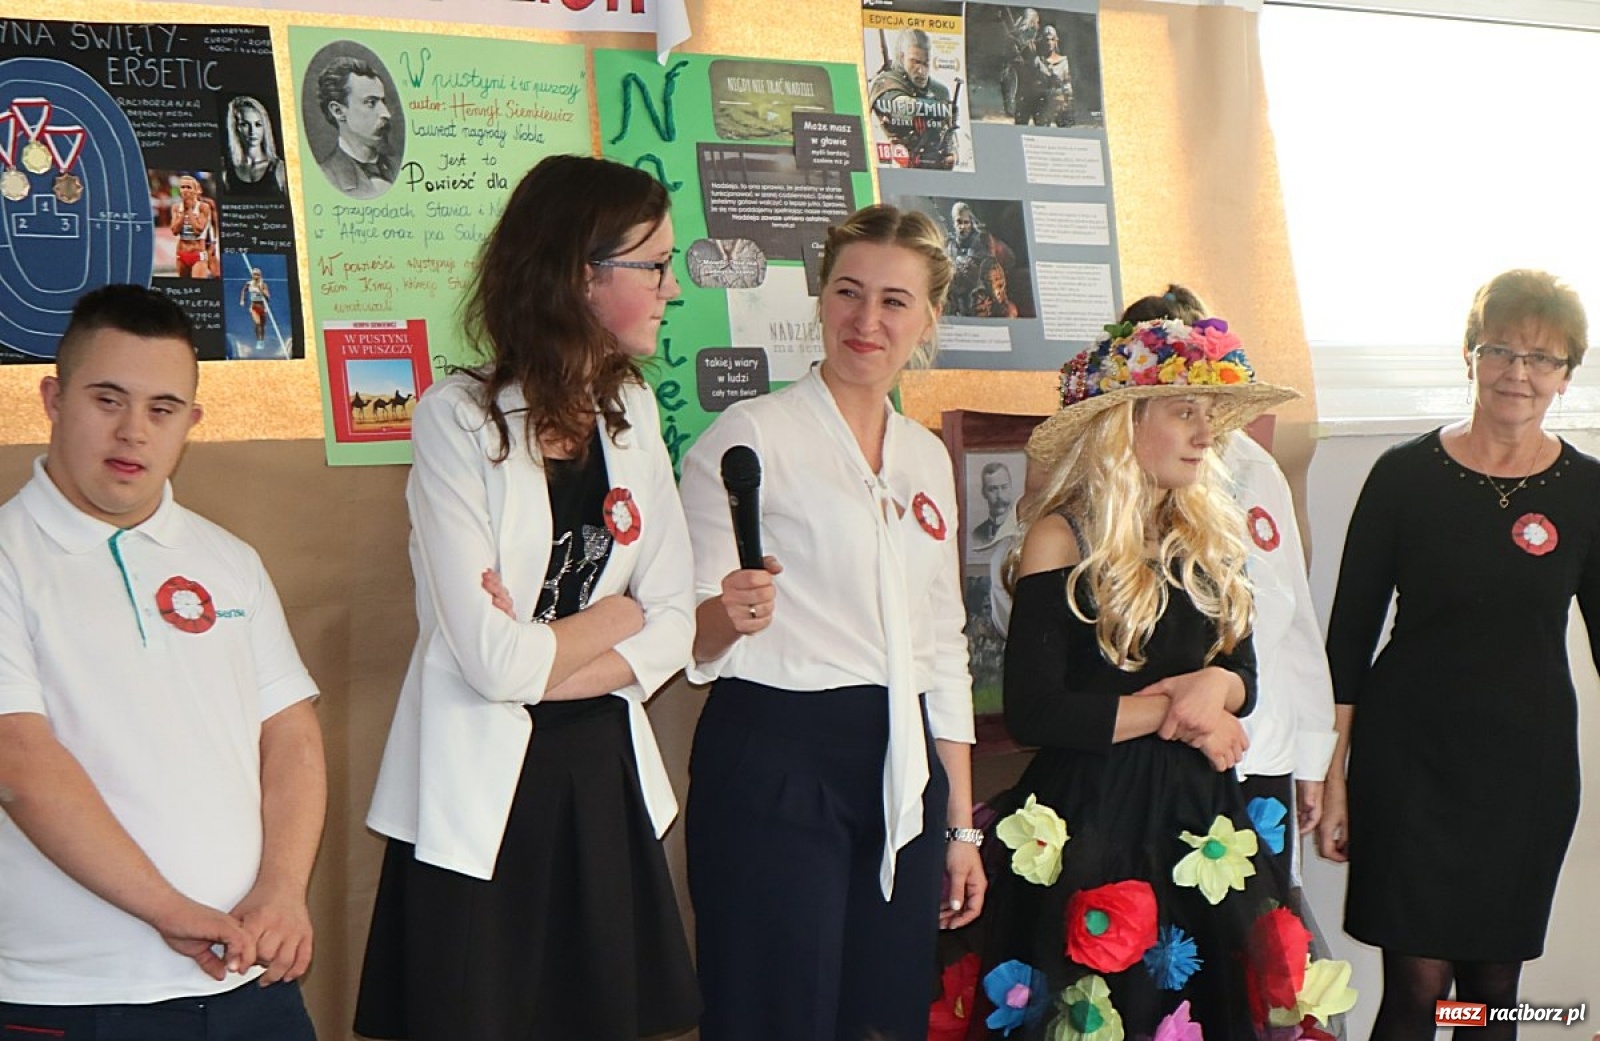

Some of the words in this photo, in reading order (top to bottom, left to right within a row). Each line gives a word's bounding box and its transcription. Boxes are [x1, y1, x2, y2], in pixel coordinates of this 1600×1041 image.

[869, 15, 904, 25] EDYCJA
[907, 18, 925, 26] GRY
[928, 20, 956, 29] ROKU
[487, 172, 508, 189] dla
[100, 211, 138, 219] START
[18, 218, 28, 229] 2
[60, 218, 70, 231] 3
[344, 334, 357, 344] W
[359, 333, 408, 344] PUSTYNI
[347, 345, 360, 355] W
[362, 344, 413, 355] PUSZCZY
[704, 357, 733, 370] takiej
[734, 357, 759, 369] wiary
[717, 374, 725, 382] w
[727, 372, 749, 382] ludzi
